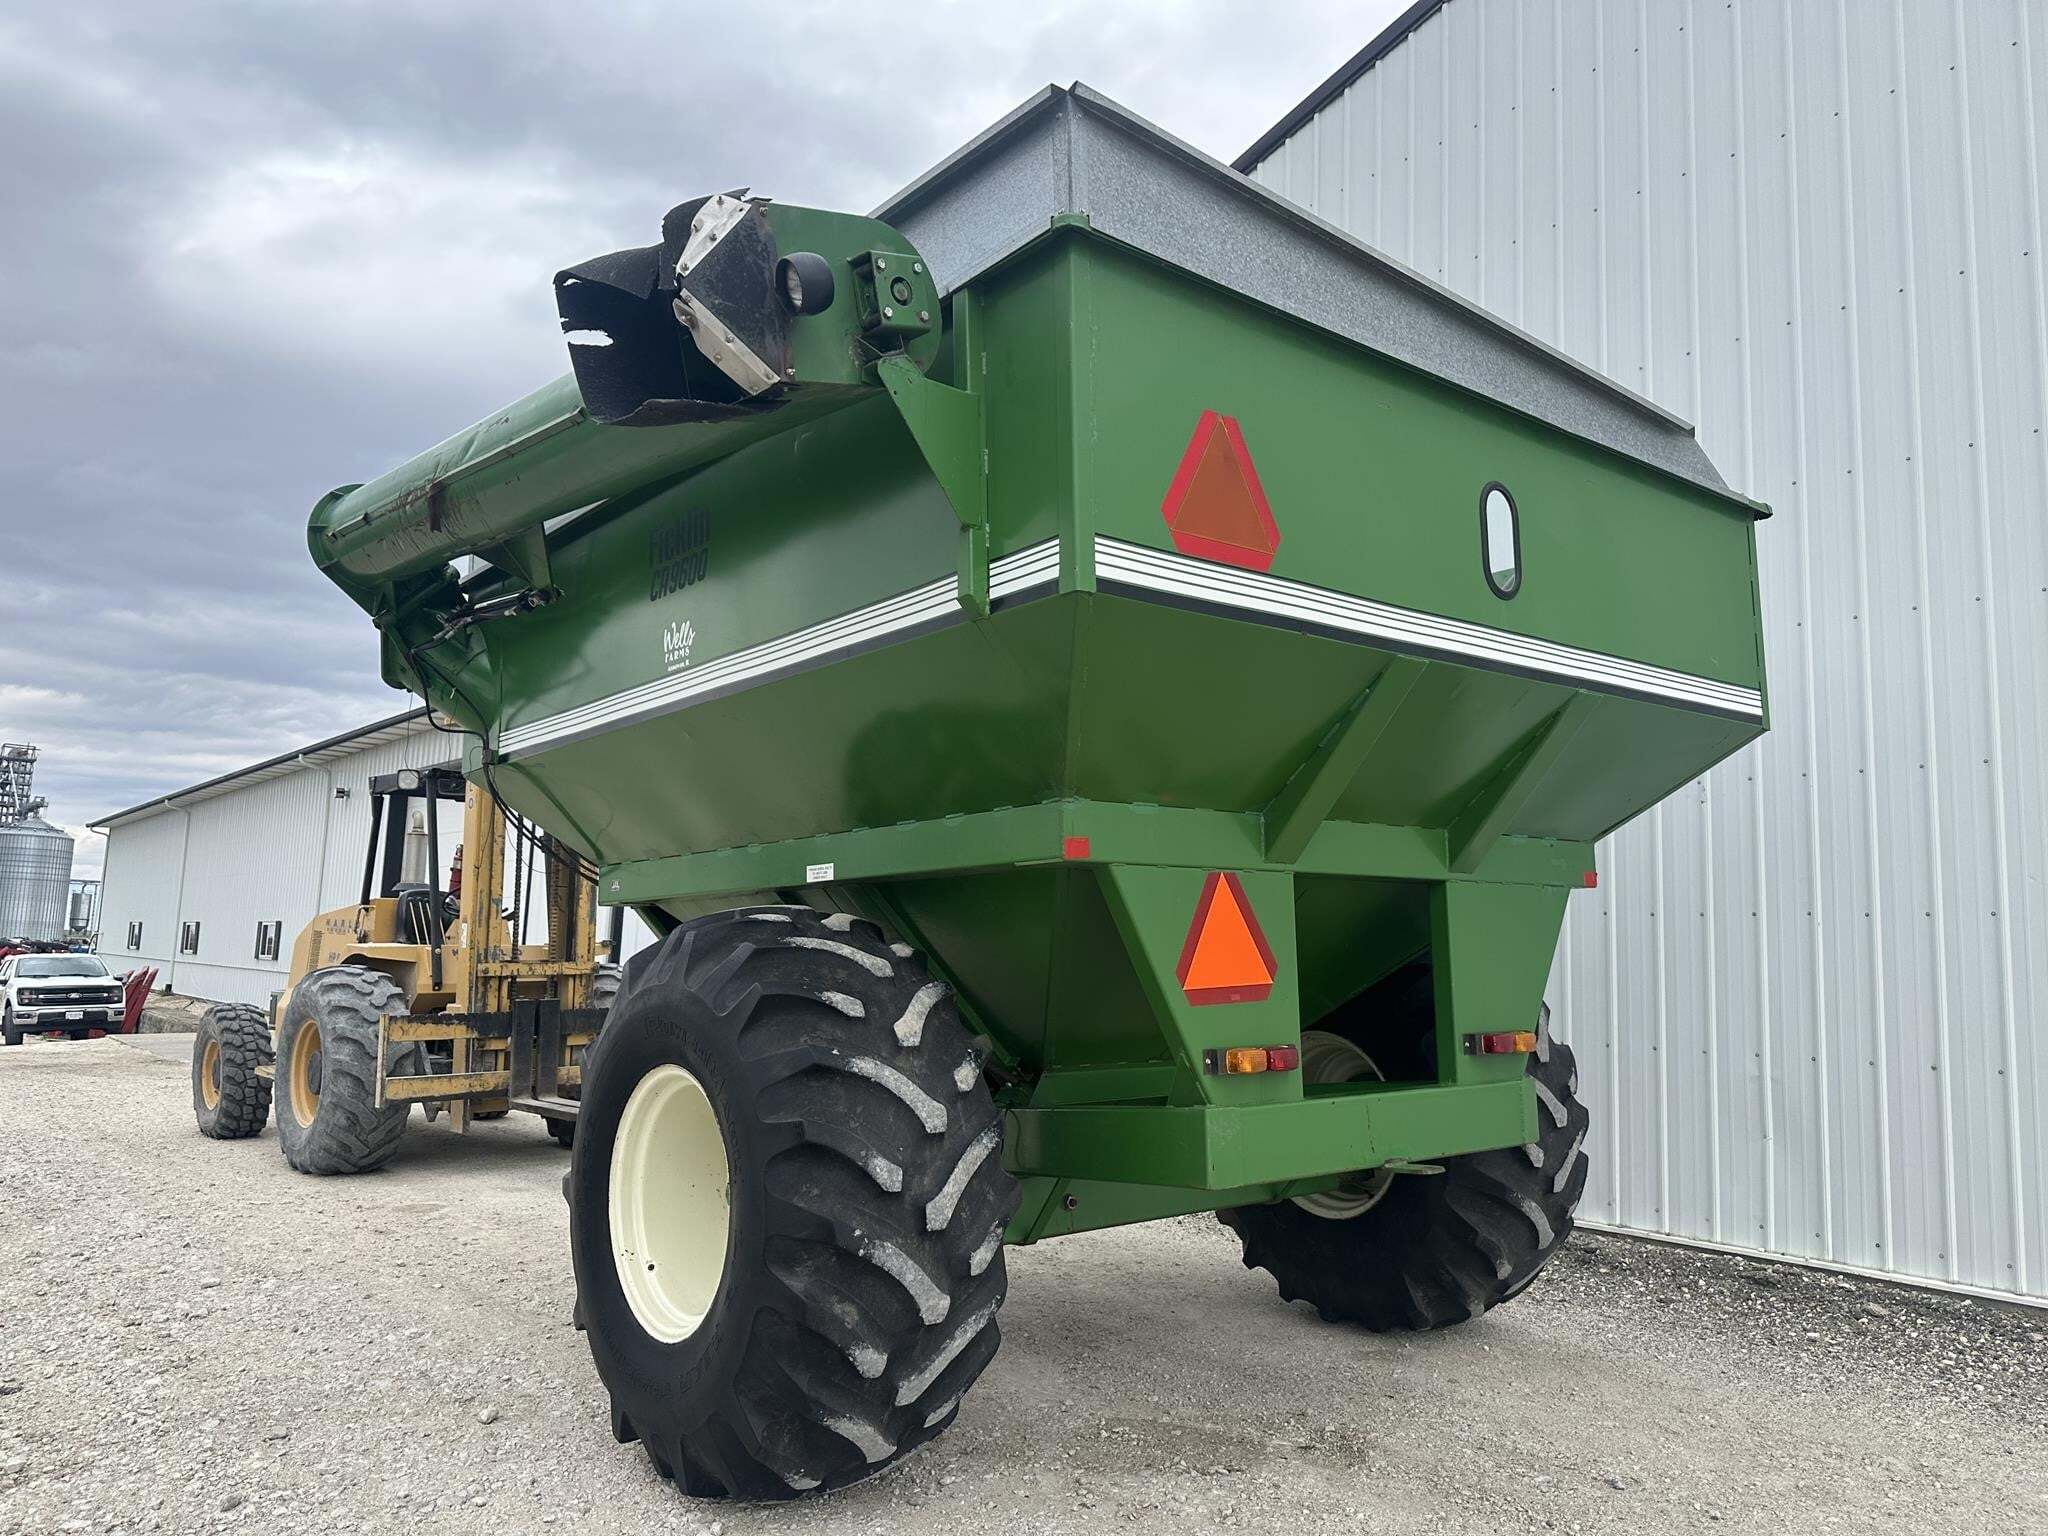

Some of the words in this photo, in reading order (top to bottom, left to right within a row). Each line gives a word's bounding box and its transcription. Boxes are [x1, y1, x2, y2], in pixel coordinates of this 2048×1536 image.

[650, 547, 709, 602] CA9600
[663, 620, 696, 653] Wells
[664, 646, 690, 664] FARMS
